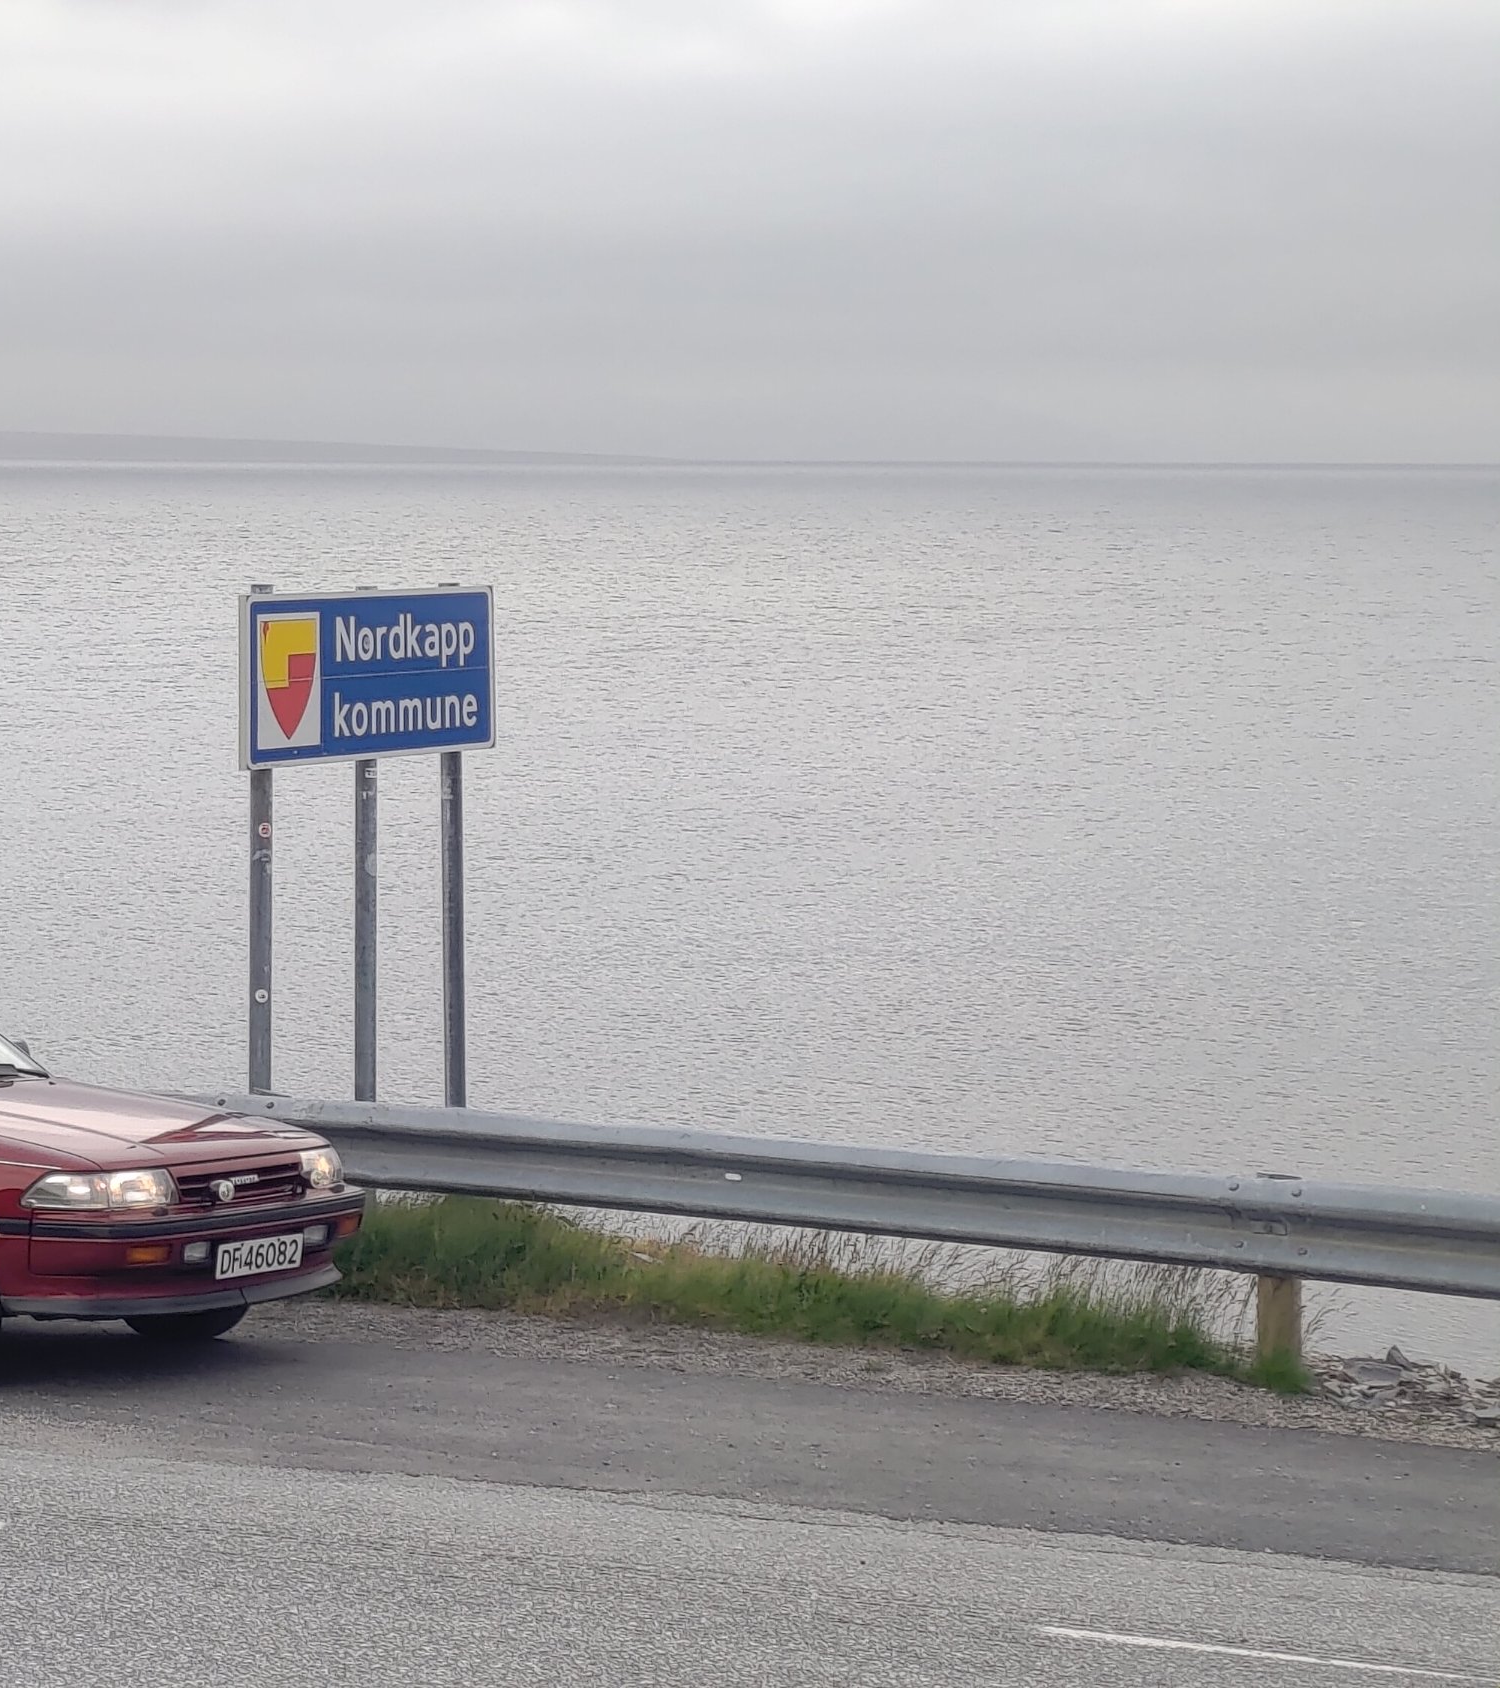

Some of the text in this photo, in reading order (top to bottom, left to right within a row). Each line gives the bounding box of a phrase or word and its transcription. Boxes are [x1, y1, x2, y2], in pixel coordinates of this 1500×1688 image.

[335, 613, 475, 667] Nordkapp
[333, 692, 478, 738] kommune
[229, 1174, 260, 1186] TOYOTA
